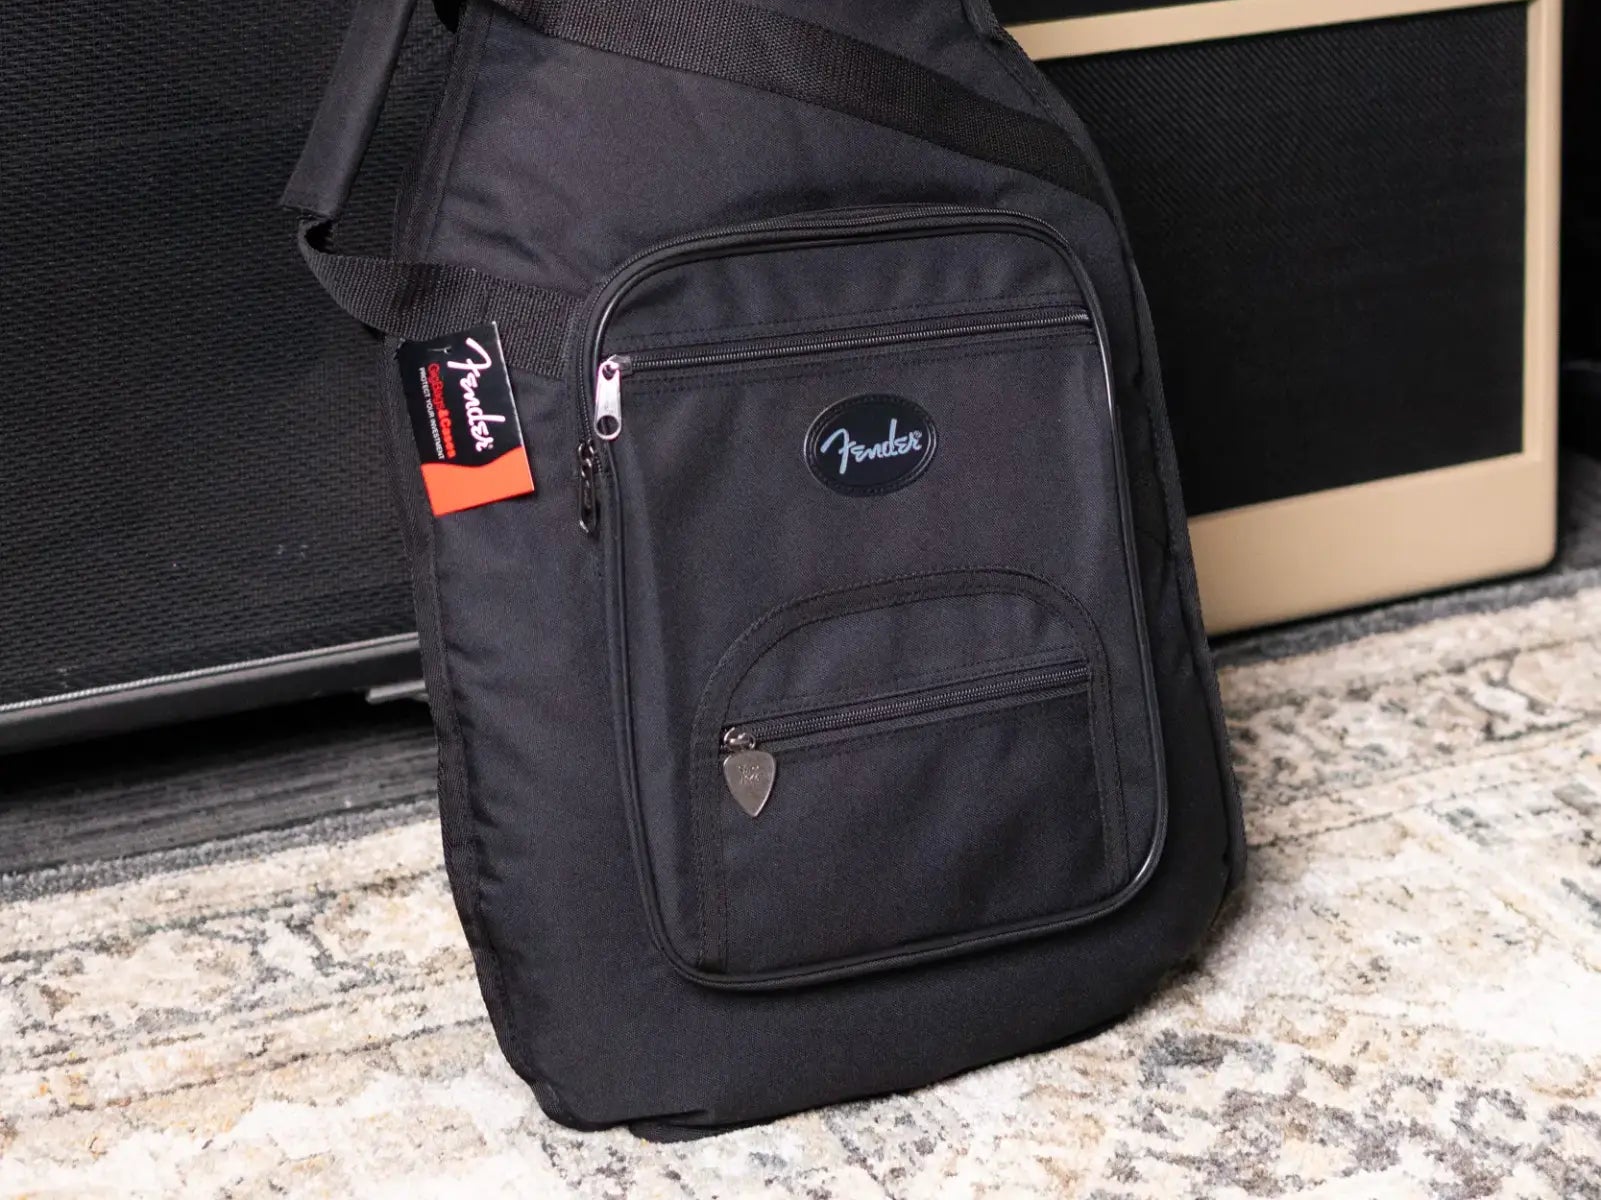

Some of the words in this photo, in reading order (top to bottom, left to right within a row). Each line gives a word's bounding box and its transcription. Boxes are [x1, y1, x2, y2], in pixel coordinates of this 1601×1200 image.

[419, 367, 430, 398] PROTECT
[425, 398, 434, 418] YOUR
[430, 418, 444, 459] INVESTMENT
[447, 337, 505, 452] Fender
[820, 418, 922, 475] Fender
